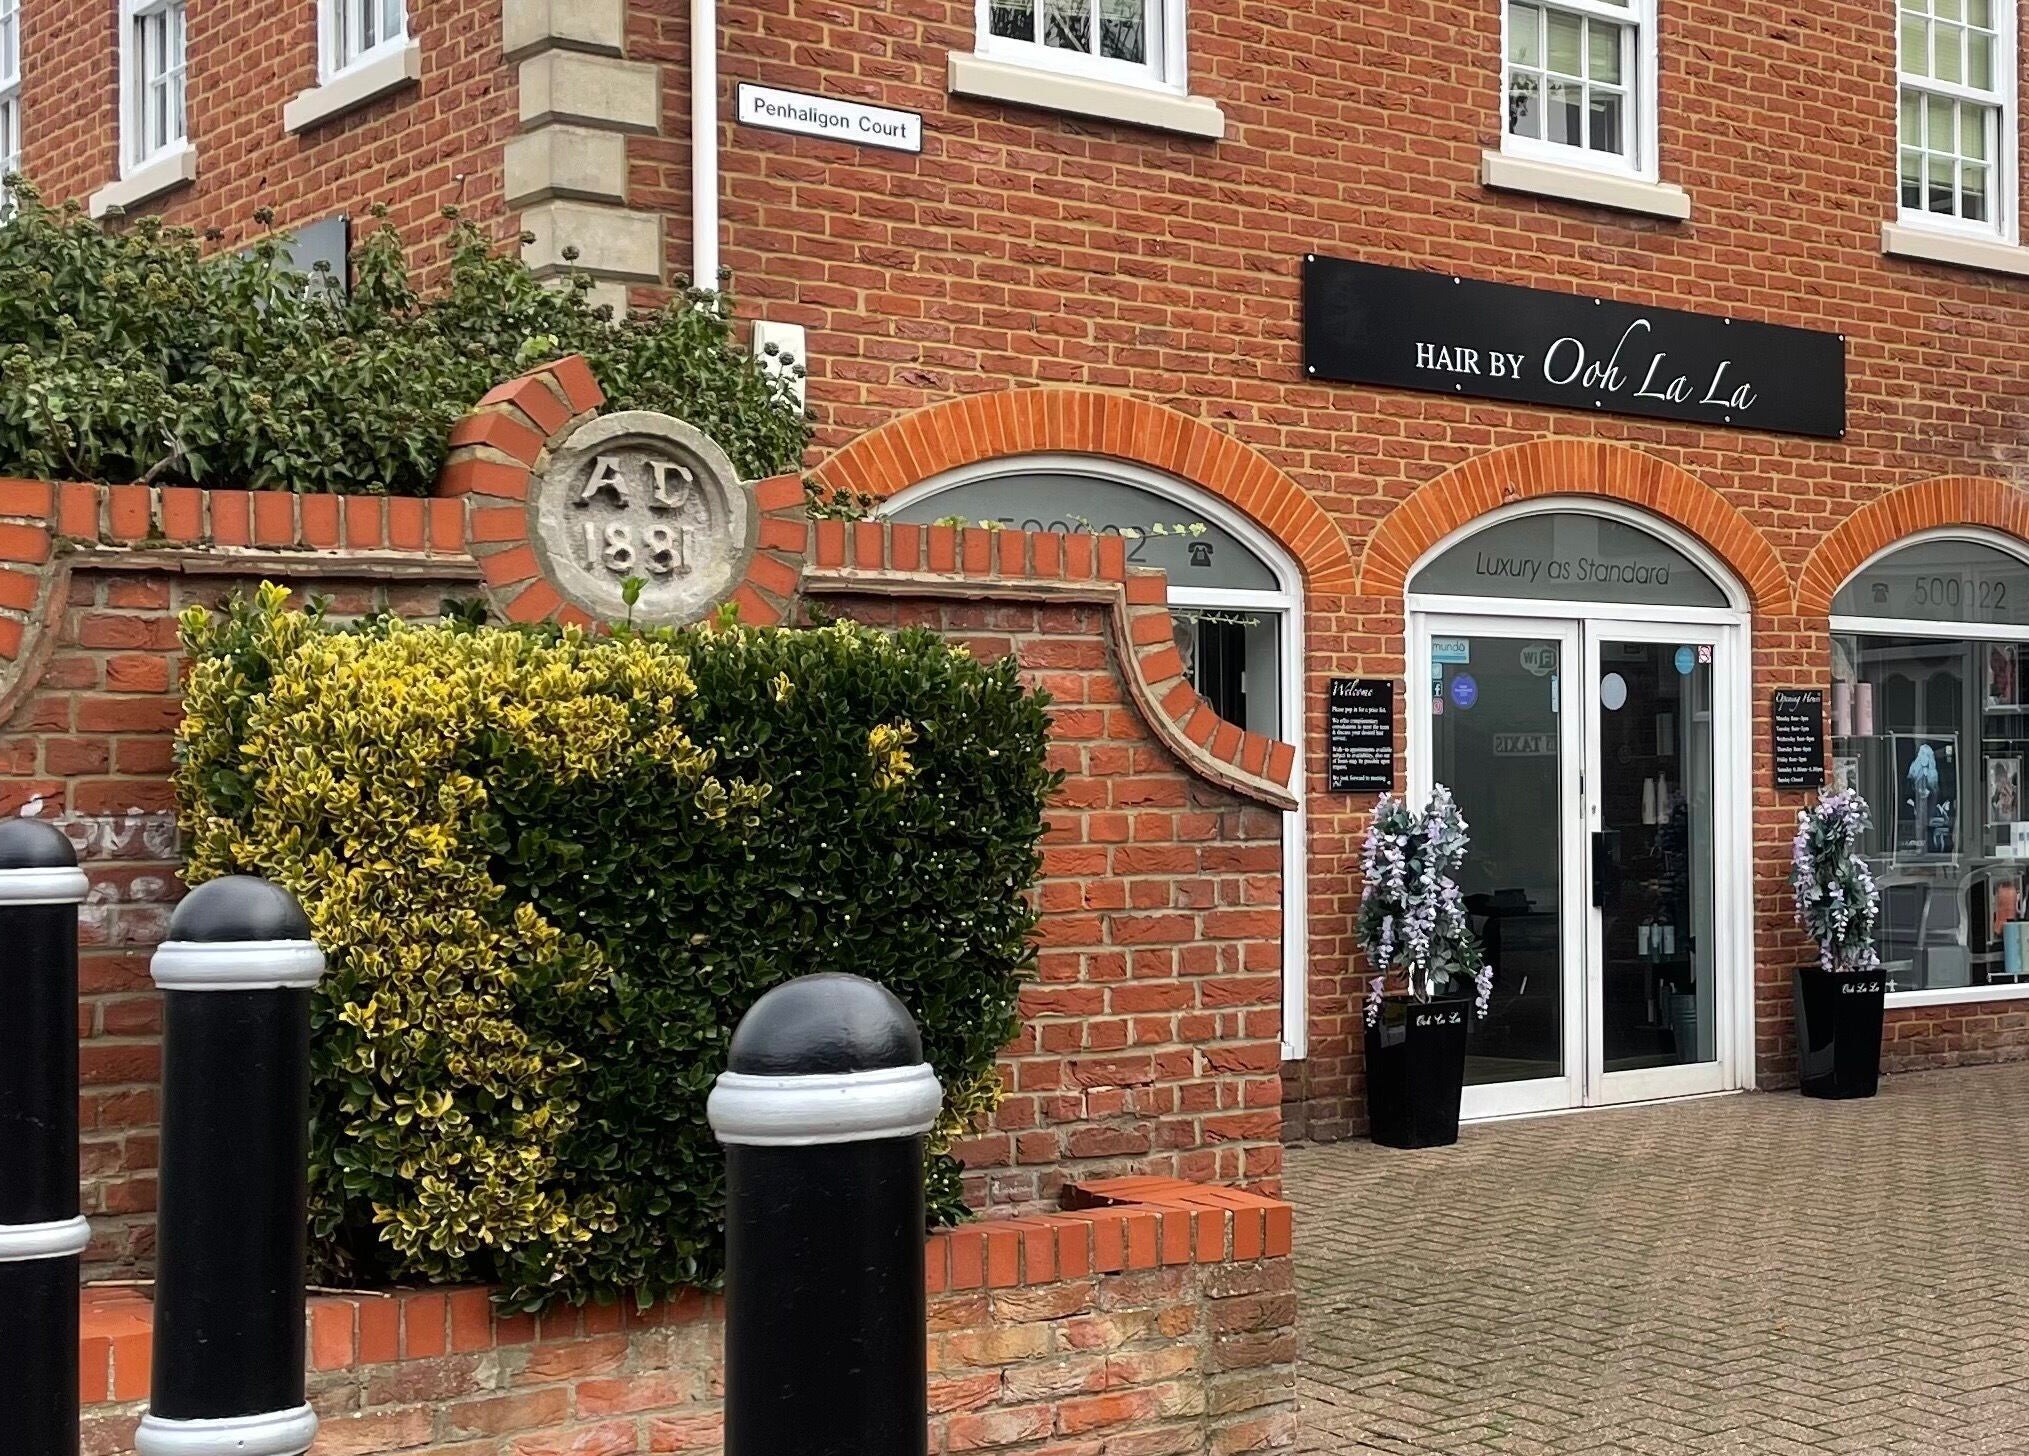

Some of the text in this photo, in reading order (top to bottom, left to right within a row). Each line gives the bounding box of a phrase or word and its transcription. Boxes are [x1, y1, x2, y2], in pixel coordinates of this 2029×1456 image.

[754, 97, 907, 138] Penhaligon Court
[1415, 318, 1758, 410] HAIR BY Ooh La La
[574, 456, 694, 508] A D
[584, 522, 694, 574] 1881
[1476, 552, 1670, 585] Luxury as Standard
[1332, 679, 1373, 696] Welcome
